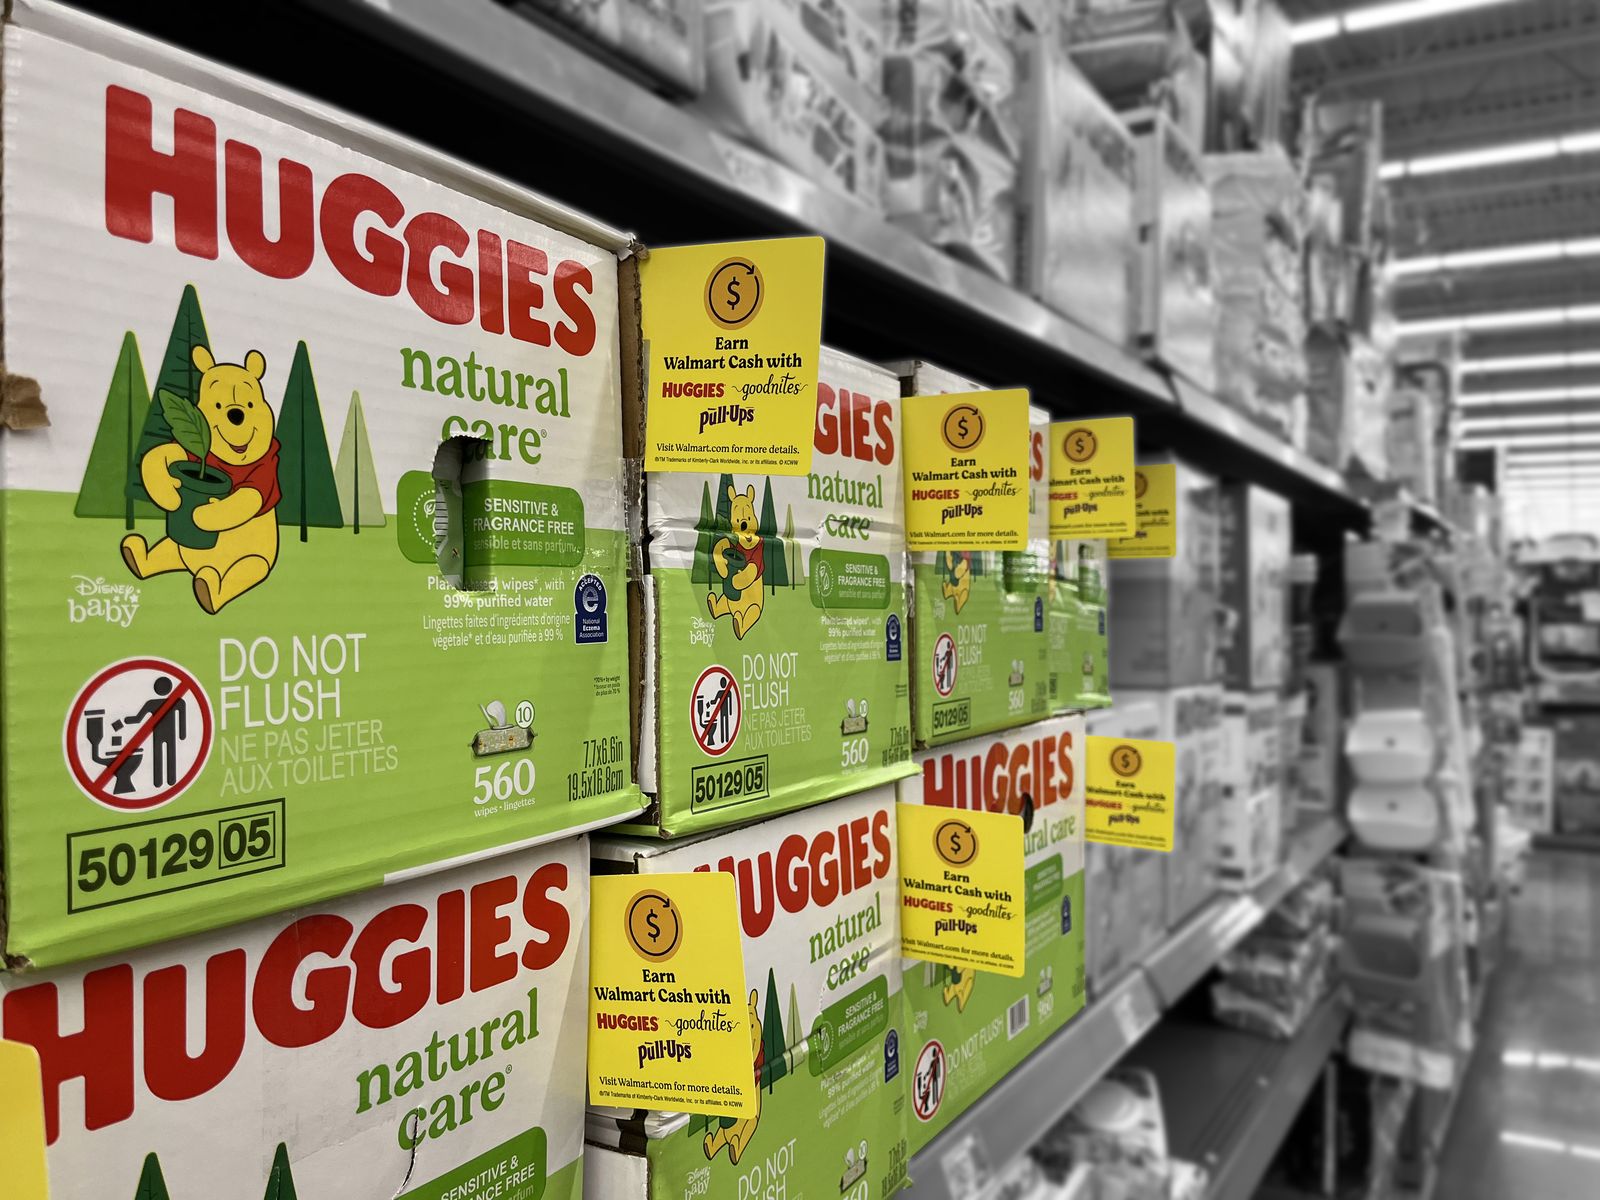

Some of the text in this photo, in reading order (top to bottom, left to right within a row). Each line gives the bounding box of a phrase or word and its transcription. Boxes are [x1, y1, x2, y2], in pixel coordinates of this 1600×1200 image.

[105, 84, 597, 357] HUGGIES
[714, 337, 749, 350] Earn
[663, 352, 802, 370] Walmart Cash with
[400, 347, 571, 418] natural
[662, 372, 807, 402] HUGGIES goodnites
[813, 382, 895, 466] GIES
[656, 443, 800, 455] Visit Walmart.com for more details.
[911, 467, 1017, 482] Walmart Cash with
[950, 457, 977, 468] Earn
[806, 470, 883, 509] natural
[911, 481, 1021, 501] HUGGIES goodnites
[1079, 475, 1125, 485] Cash with
[484, 498, 559, 516] SENSITIVE &
[473, 516, 575, 535] FRAGRANCE FREE
[924, 530, 966, 538] Walmart.com
[966, 530, 976, 538] for
[511, 535, 521, 550] et
[523, 540, 542, 551] sans
[544, 577, 566, 591] with
[67, 597, 140, 628] baby
[443, 593, 554, 611] 99% purified water
[422, 615, 464, 633] Lingettes
[465, 614, 489, 628] faites
[582, 617, 601, 626] National
[971, 623, 987, 644] NOT
[474, 633, 484, 646] et
[543, 628, 555, 642] 99
[579, 631, 605, 639] Association
[220, 633, 367, 683] DO NOT
[742, 654, 765, 682] DO
[769, 652, 799, 679] NOT
[958, 644, 982, 666] FLUSH
[220, 678, 340, 731] FLUSH
[743, 681, 789, 711] FLUSH
[518, 706, 532, 723] 10
[743, 707, 806, 733] NE PAS JETER
[934, 708, 958, 729] 50129
[221, 718, 385, 766] NE PAS JETER
[743, 724, 812, 751] AUX TOILETTES
[841, 737, 869, 768] 560
[219, 744, 399, 798] AUX TOILETTES
[473, 758, 536, 805] 560
[922, 731, 1074, 815] HUGGIES
[695, 766, 763, 804] 50129 05
[474, 796, 536, 818] wipes lingettes
[1050, 815, 1076, 844] care
[78, 817, 272, 893] 50129 05
[943, 870, 970, 883] Earn
[903, 877, 1012, 902] Walmart Cash with
[903, 895, 1017, 921] HUGGIES goodnites
[809, 890, 882, 964] natural
[916, 938, 960, 953] Walmart.com
[960, 945, 970, 955] for
[971, 948, 990, 958] more
[642, 968, 676, 983] Earn
[2, 862, 571, 1147] HUGGIES
[593, 987, 732, 1004] Walmart Cash with
[596, 1009, 740, 1037] HUGGIES goodnites
[961, 1033, 979, 1061] NOT
[980, 1013, 1005, 1050] FLUSH
[355, 986, 540, 1115] natural
[599, 1076, 743, 1096] Visit Walmart.com for more details.
[510, 1154, 519, 1170] &
[738, 1165, 762, 1200] DO
[766, 1138, 797, 1185] NOT
[505, 1162, 536, 1192] FREE
